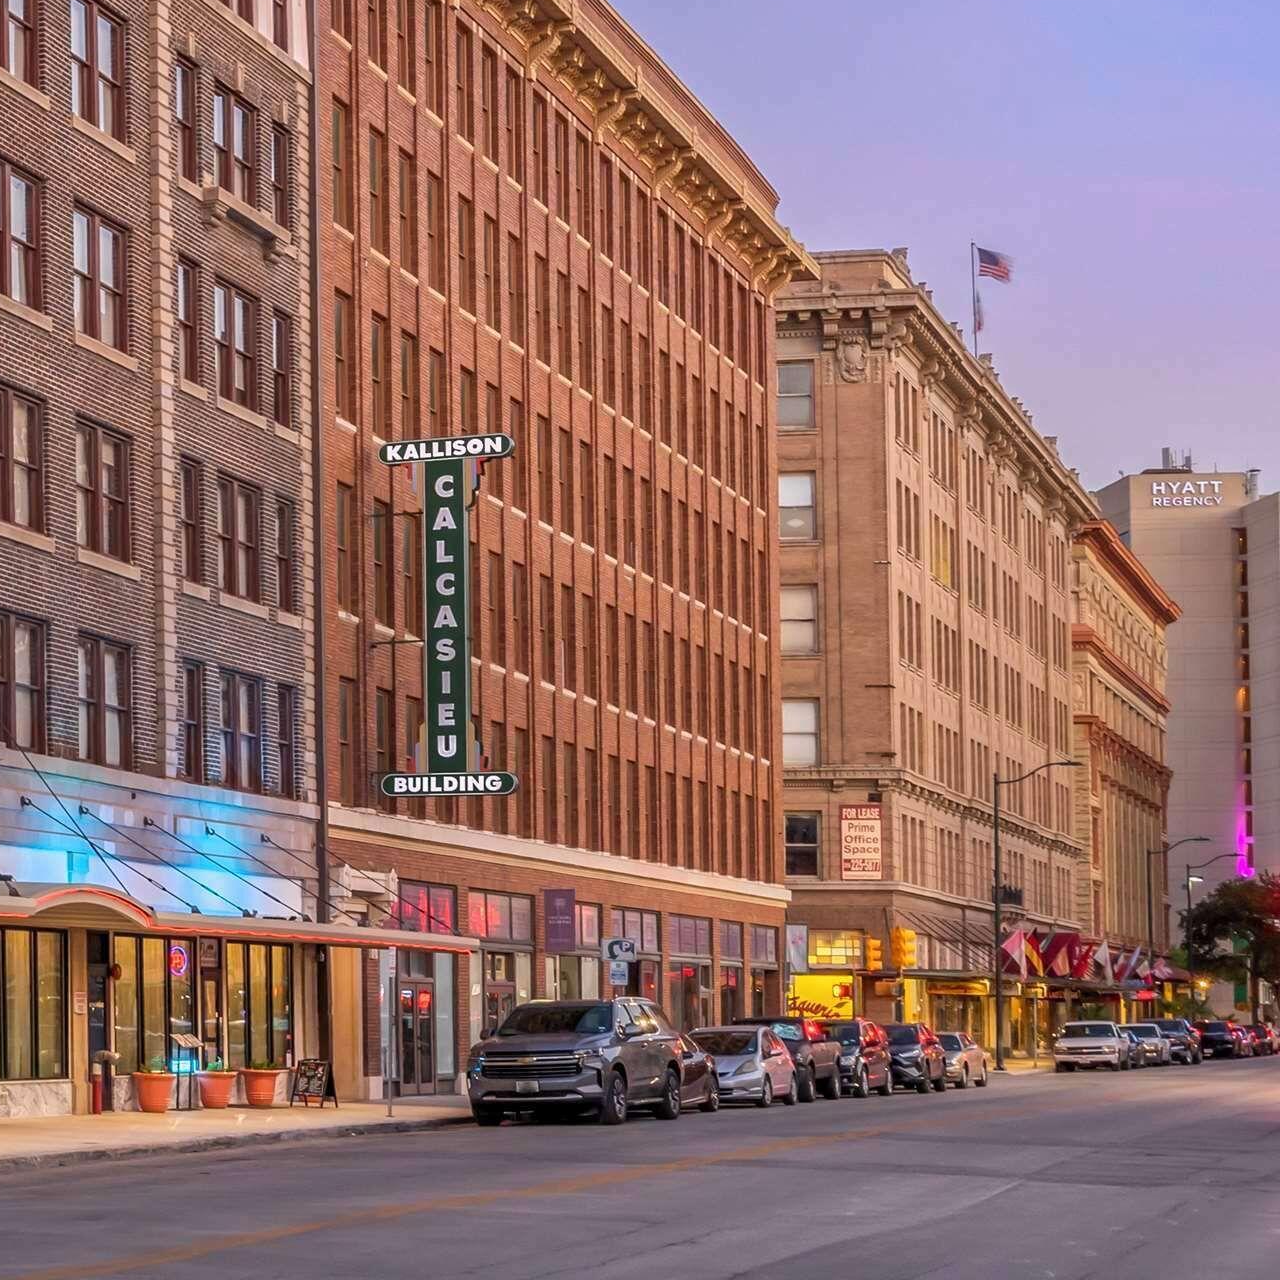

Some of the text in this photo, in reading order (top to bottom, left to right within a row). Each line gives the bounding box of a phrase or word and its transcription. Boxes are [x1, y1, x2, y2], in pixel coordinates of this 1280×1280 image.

[386, 437, 503, 462] KALLISON
[1152, 481, 1223, 495] HYATT
[1152, 496, 1223, 507] REGENCY
[432, 474, 458, 758] CALCASIEU
[393, 774, 502, 794] BUILDING
[842, 808, 880, 819] FOR LEASE
[848, 823, 875, 832] Prime
[844, 835, 879, 844] Office
[844, 845, 880, 855] Space
